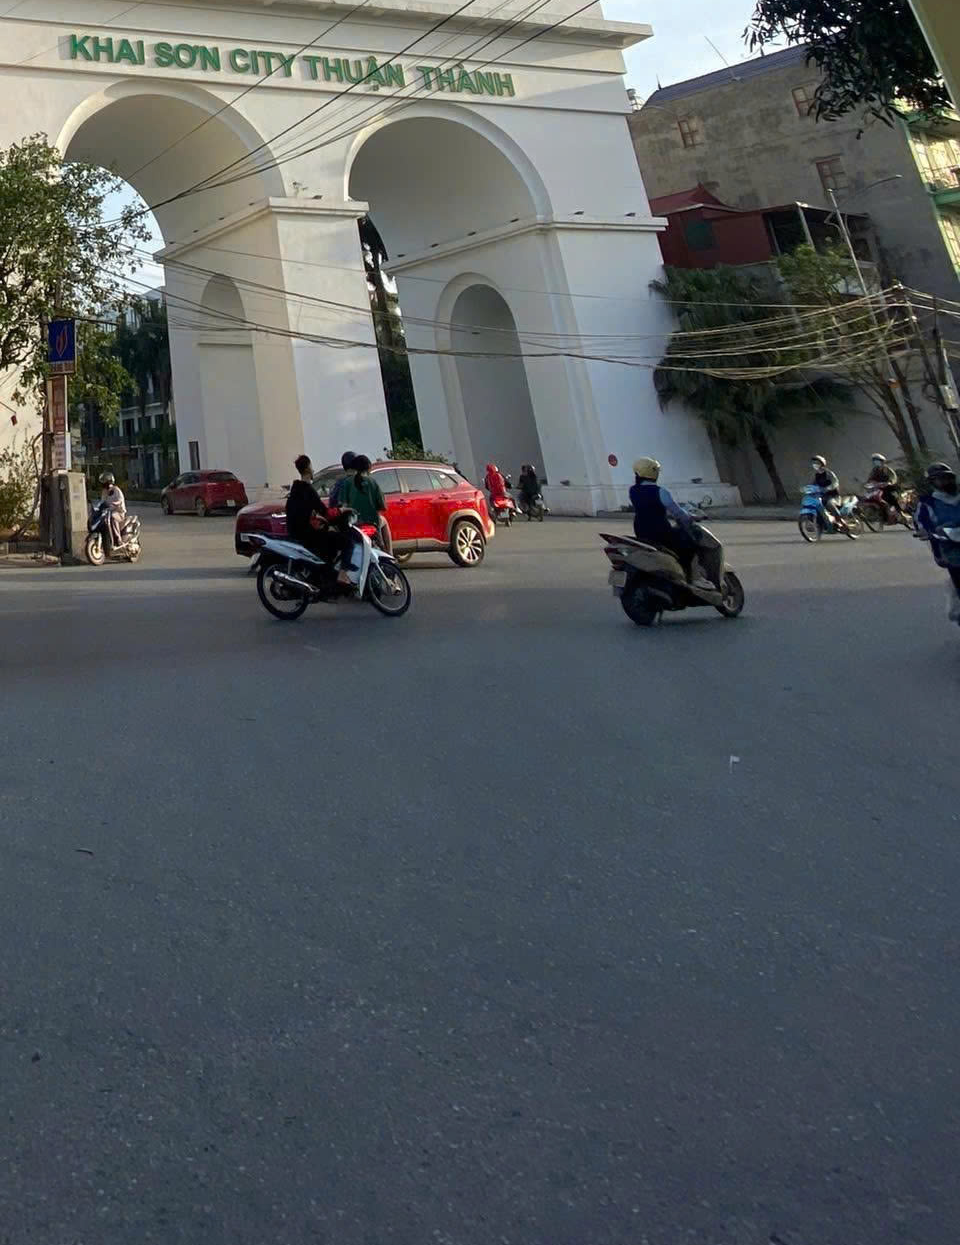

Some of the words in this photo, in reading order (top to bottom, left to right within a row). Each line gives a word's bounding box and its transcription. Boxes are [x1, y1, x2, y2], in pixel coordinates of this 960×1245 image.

[70, 34, 145, 65] KHAI
[154, 42, 220, 71] SƠN
[229, 48, 296, 77] CITY
[303, 55, 406, 92] THUẬN
[416, 63, 515, 97] THÀNH
